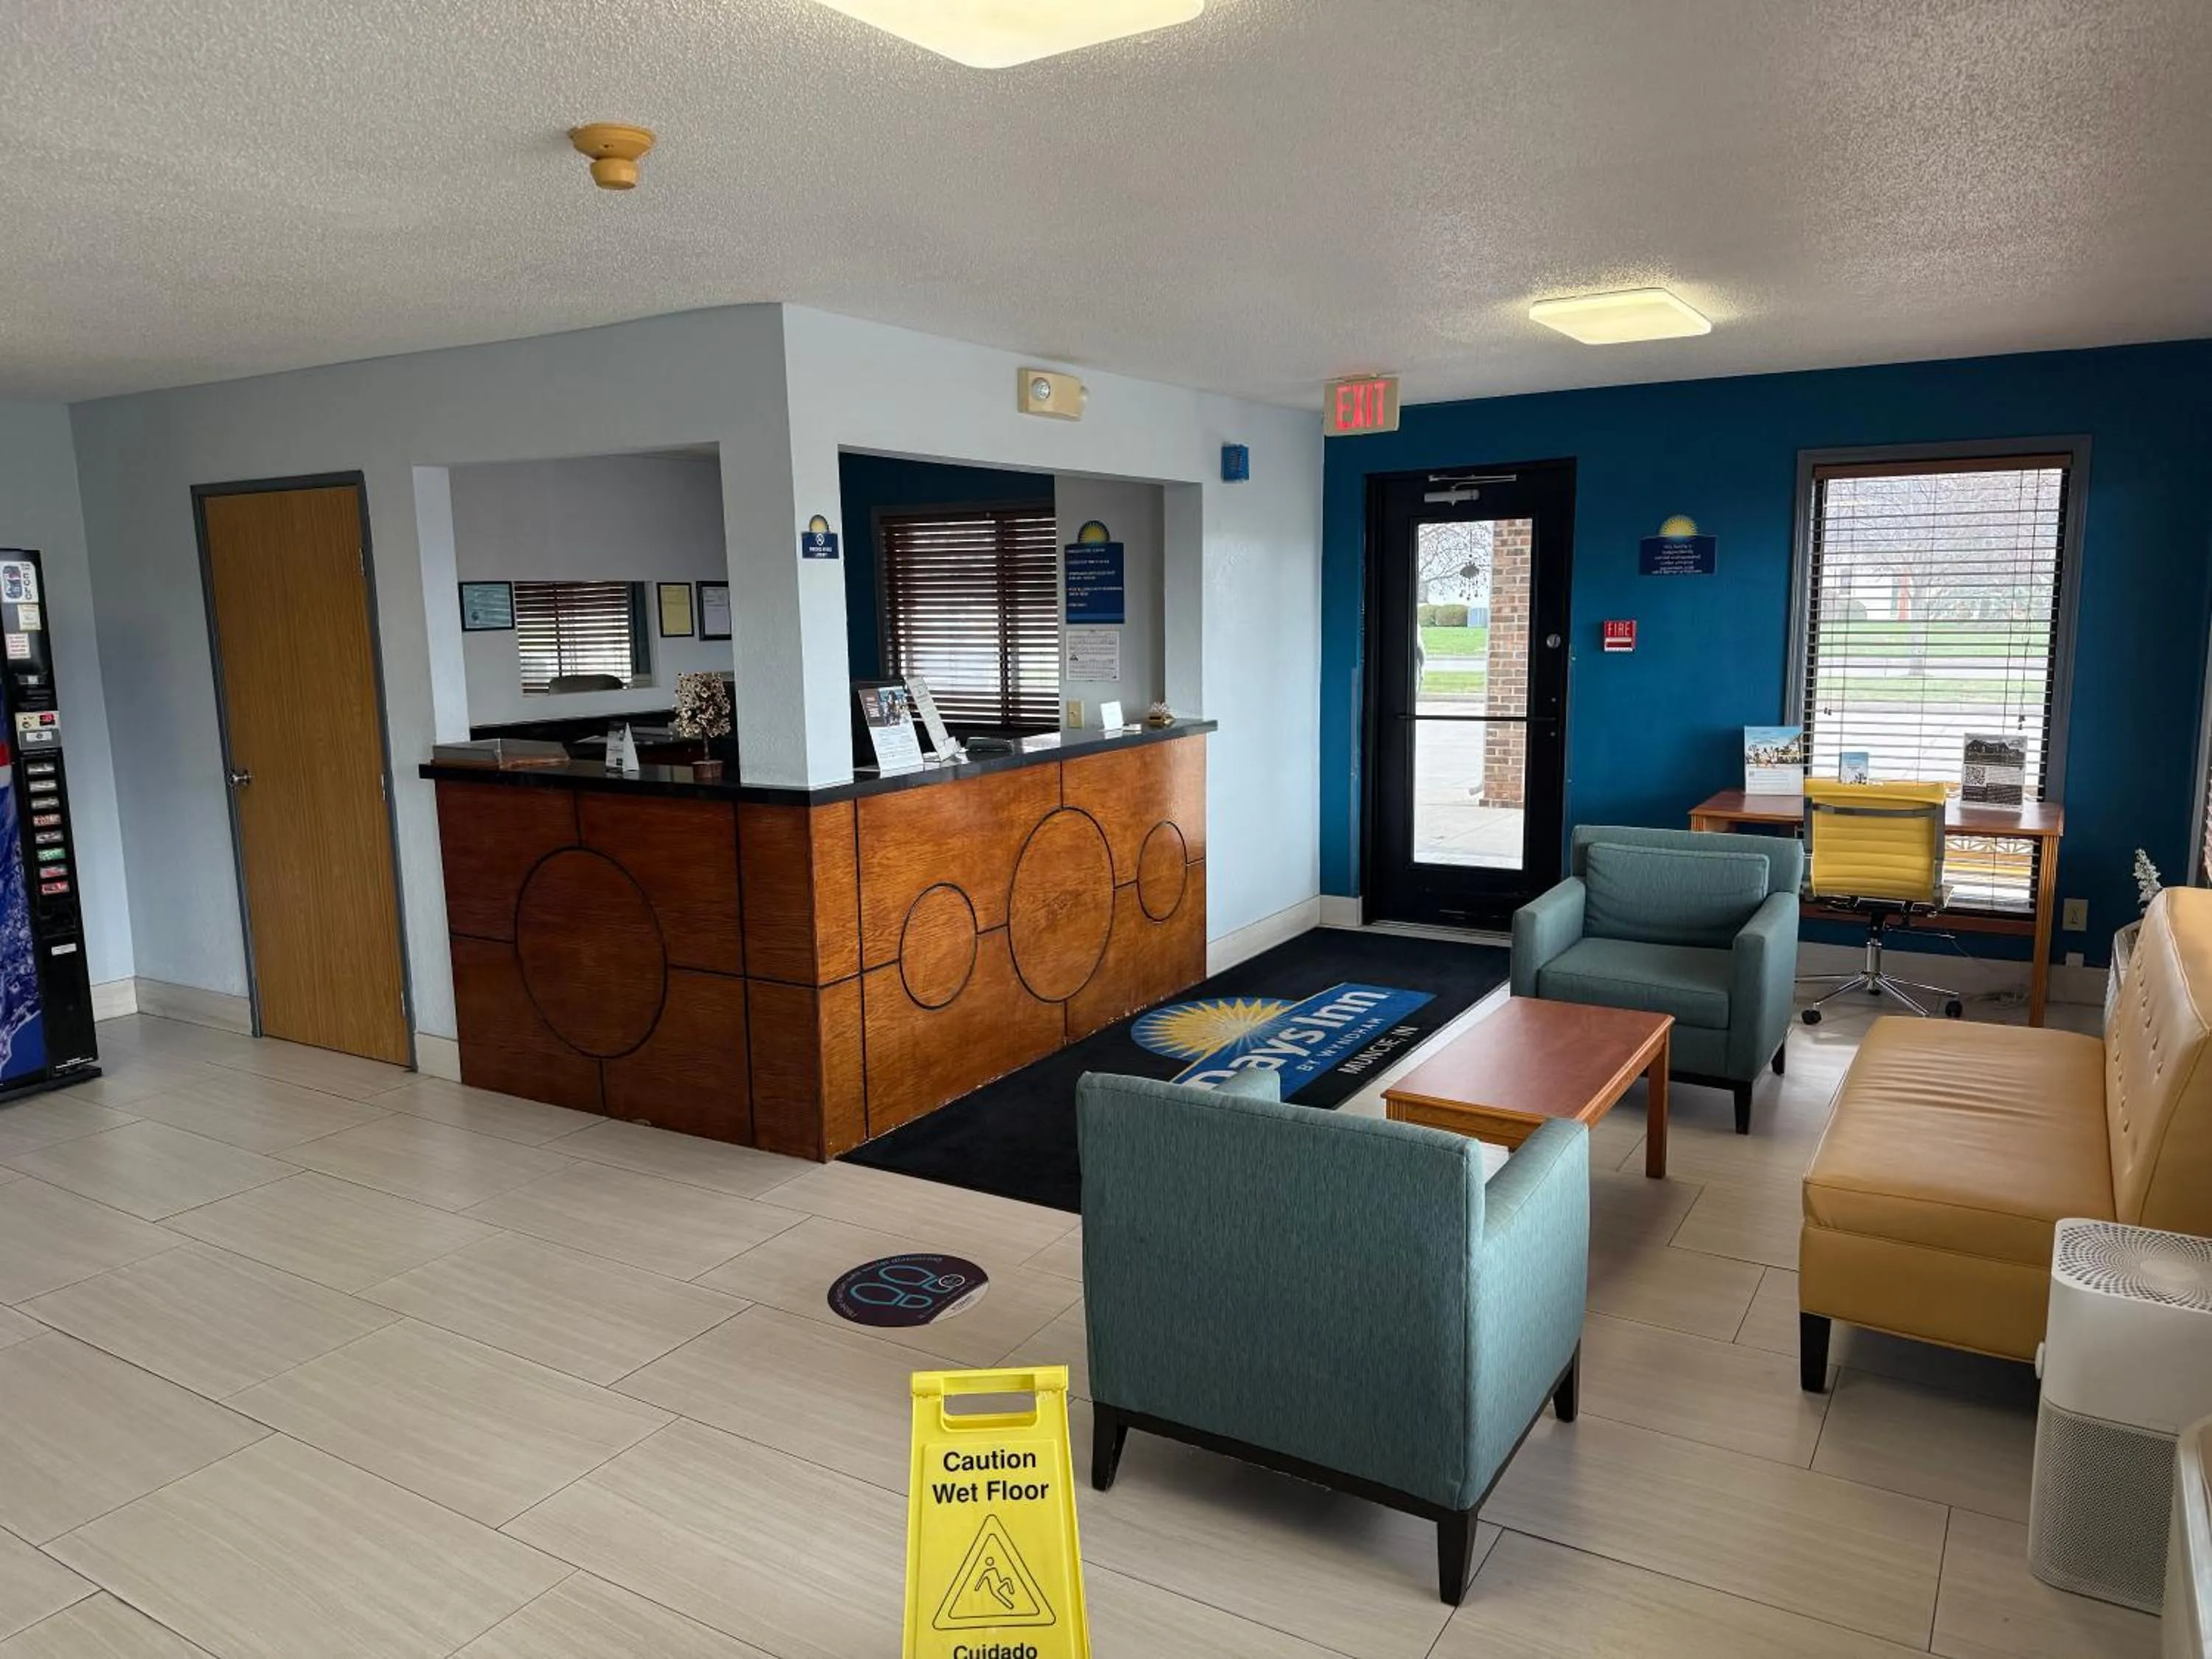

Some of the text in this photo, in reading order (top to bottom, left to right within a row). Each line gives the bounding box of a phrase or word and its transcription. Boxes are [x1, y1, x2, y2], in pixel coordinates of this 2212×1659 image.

[1335, 380, 1389, 429] EXIT
[1607, 622, 1631, 637] FIRE
[1295, 1018, 1385, 1071] BY WYNDHAM
[943, 1449, 1036, 1472] Caution
[932, 1480, 1049, 1504] Wet Floor
[953, 1642, 1038, 1659] Cuidado
